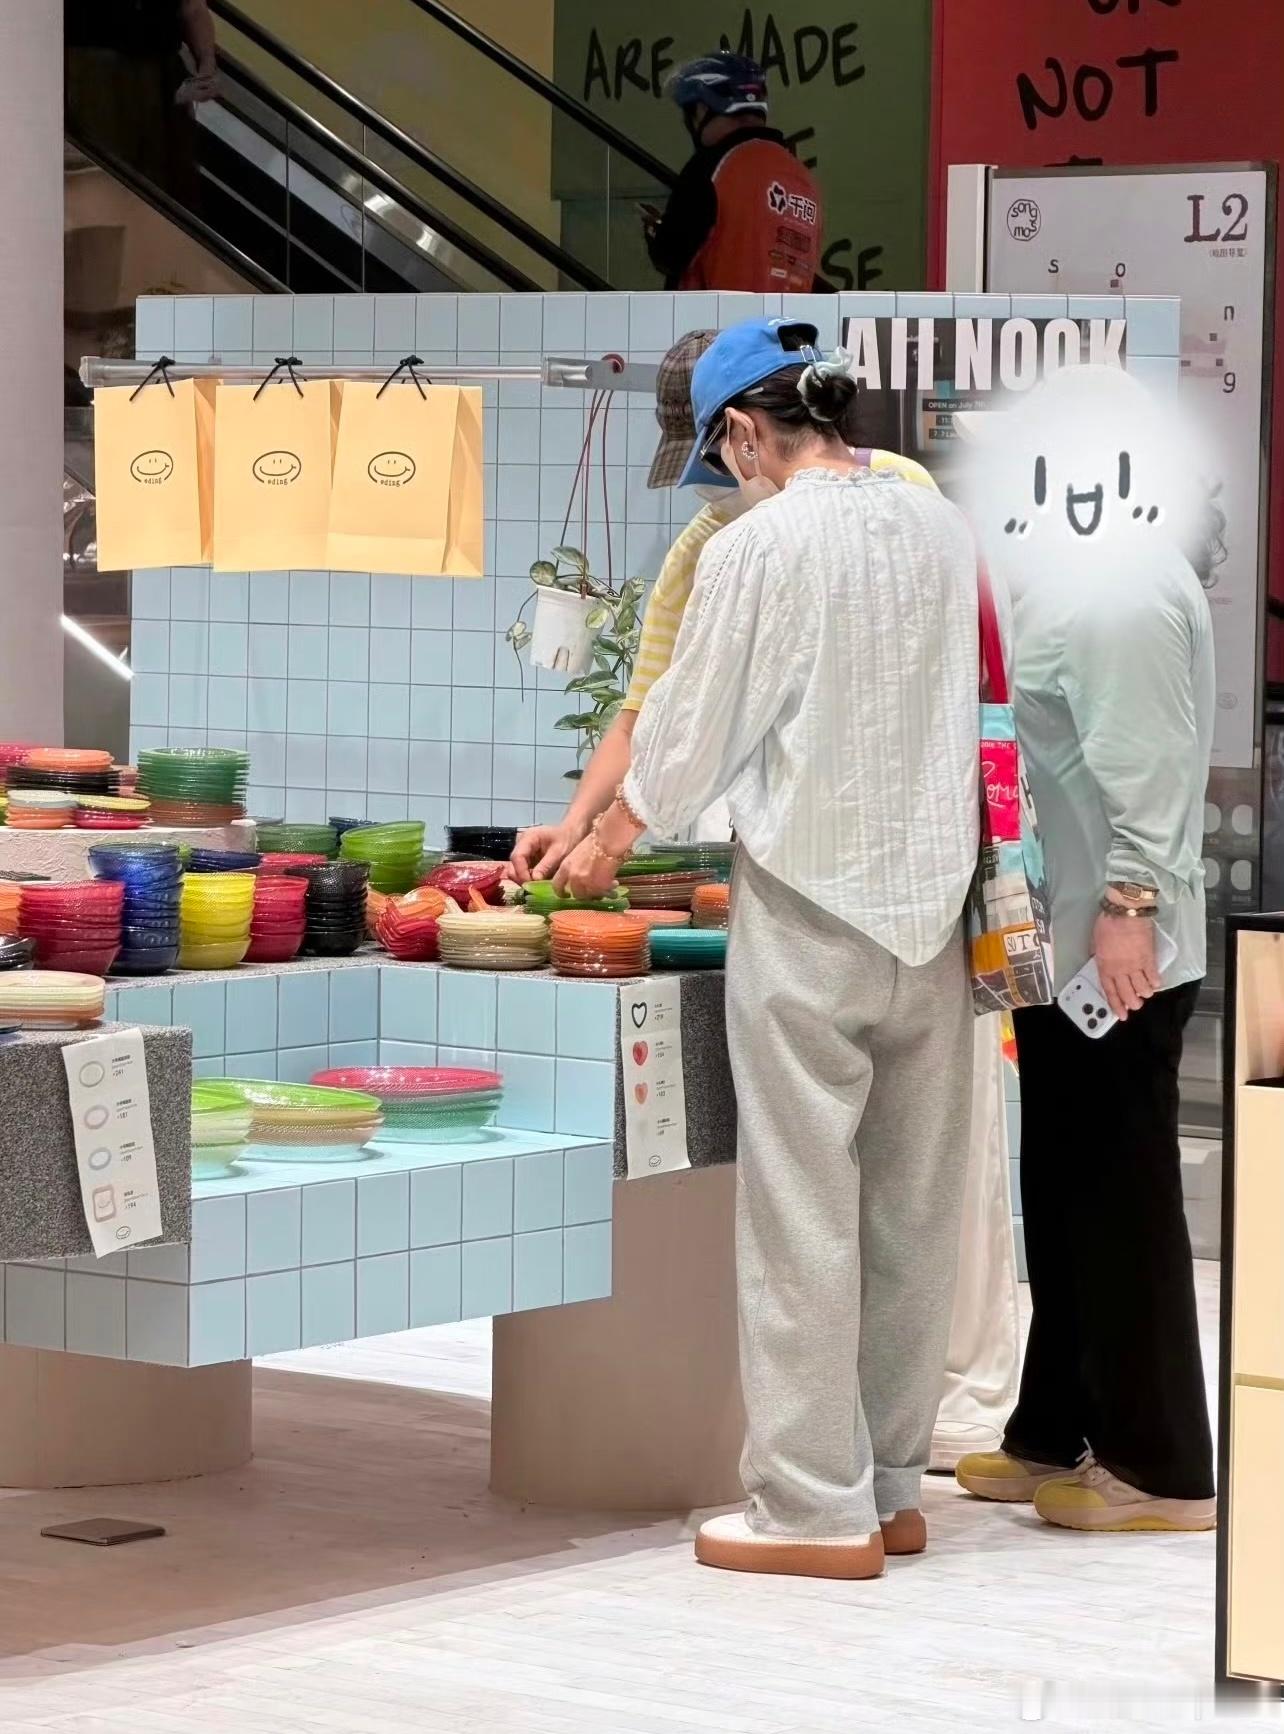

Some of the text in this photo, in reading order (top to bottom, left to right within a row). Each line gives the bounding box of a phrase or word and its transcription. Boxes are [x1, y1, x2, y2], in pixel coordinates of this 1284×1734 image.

[1016, 47, 1179, 130] NOT
[1184, 193, 1249, 243] L2
[928, 401, 948, 410] OPEN
